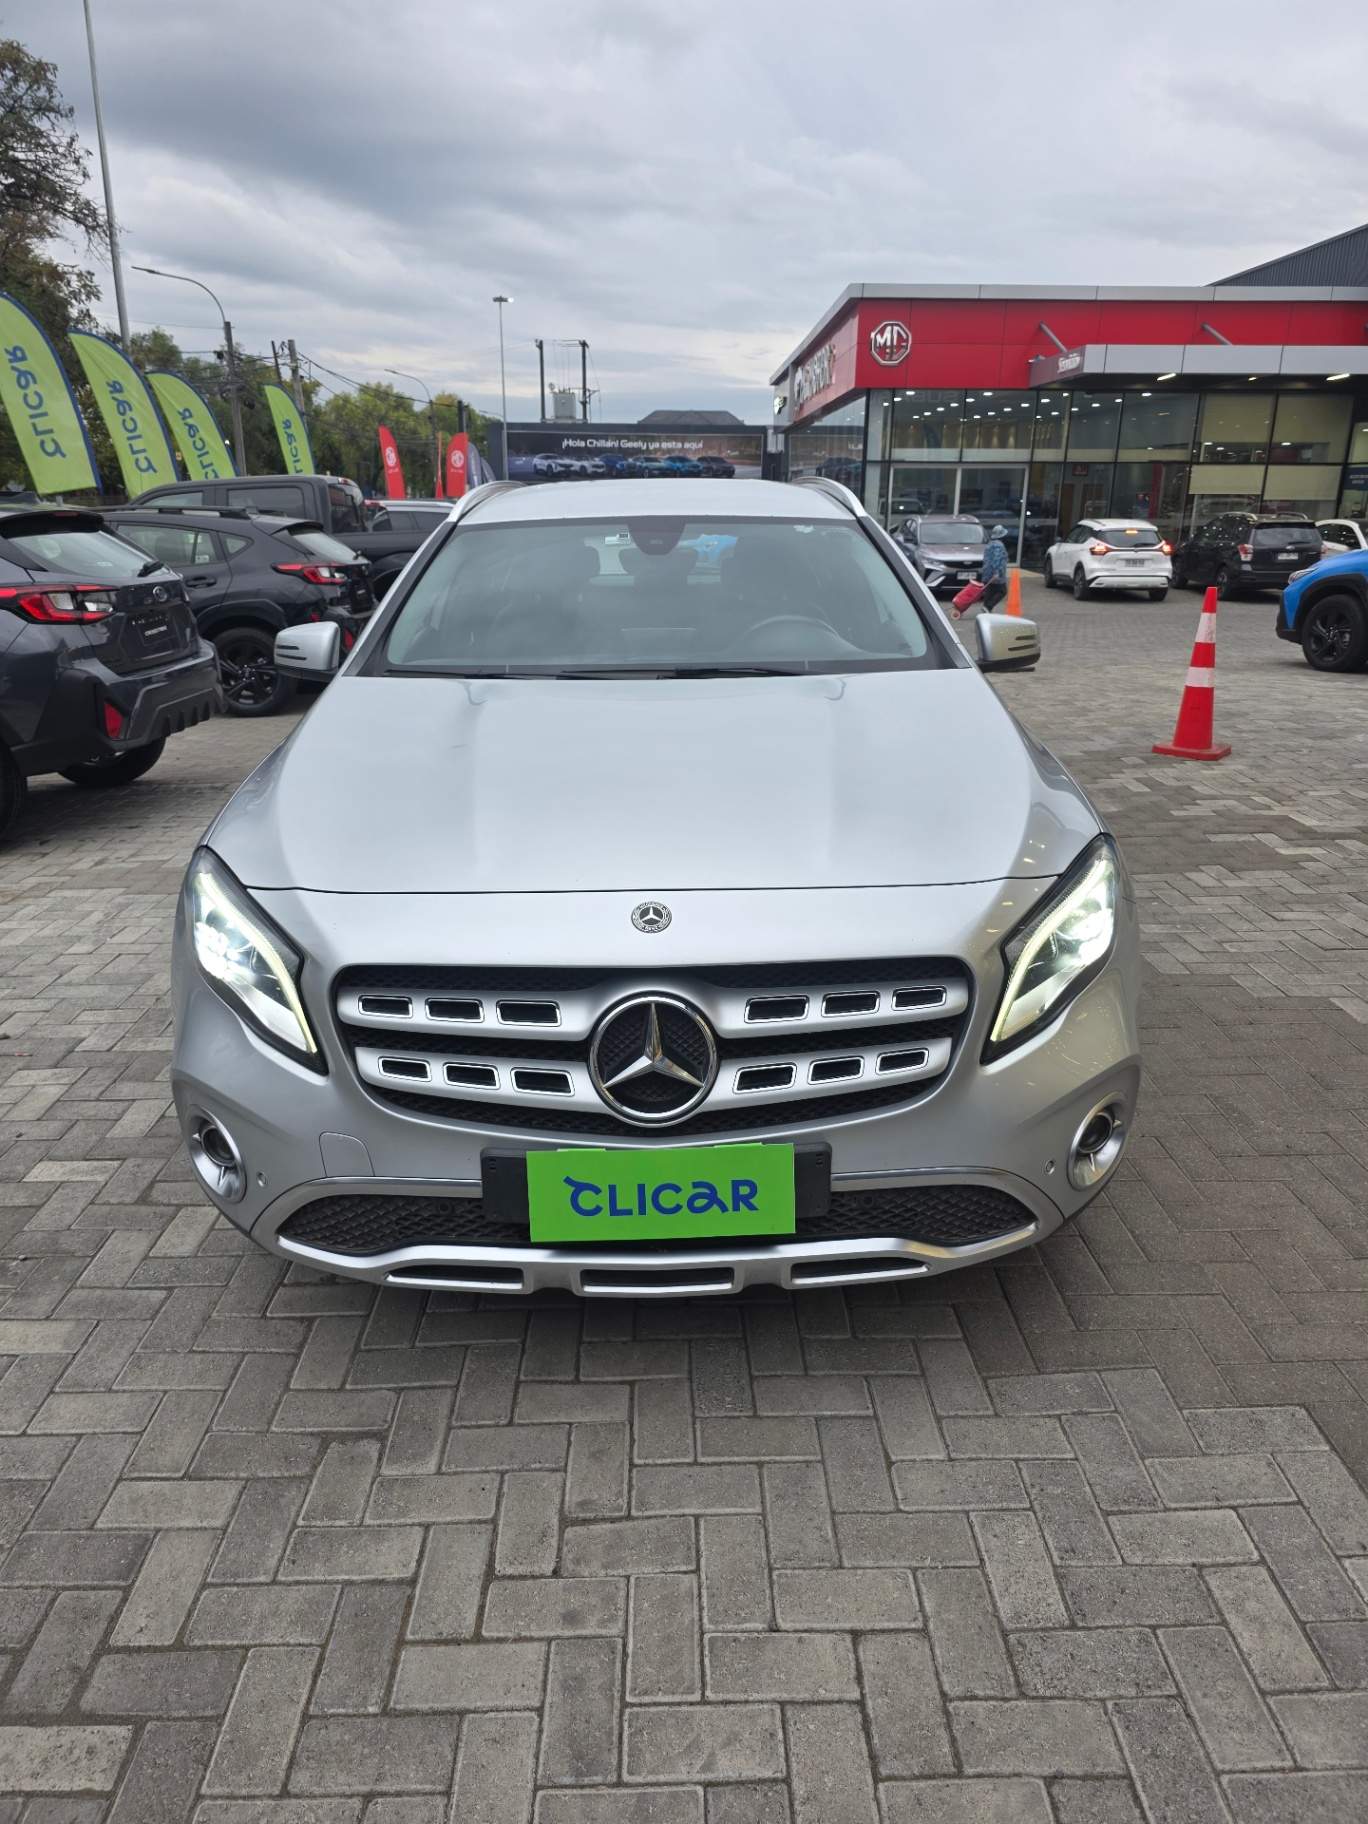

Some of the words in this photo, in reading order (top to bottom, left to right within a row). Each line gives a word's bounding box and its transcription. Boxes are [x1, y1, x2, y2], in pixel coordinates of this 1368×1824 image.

[875, 325, 908, 361] MG
[620, 439, 647, 450] Geely
[648, 441, 660, 450] ya
